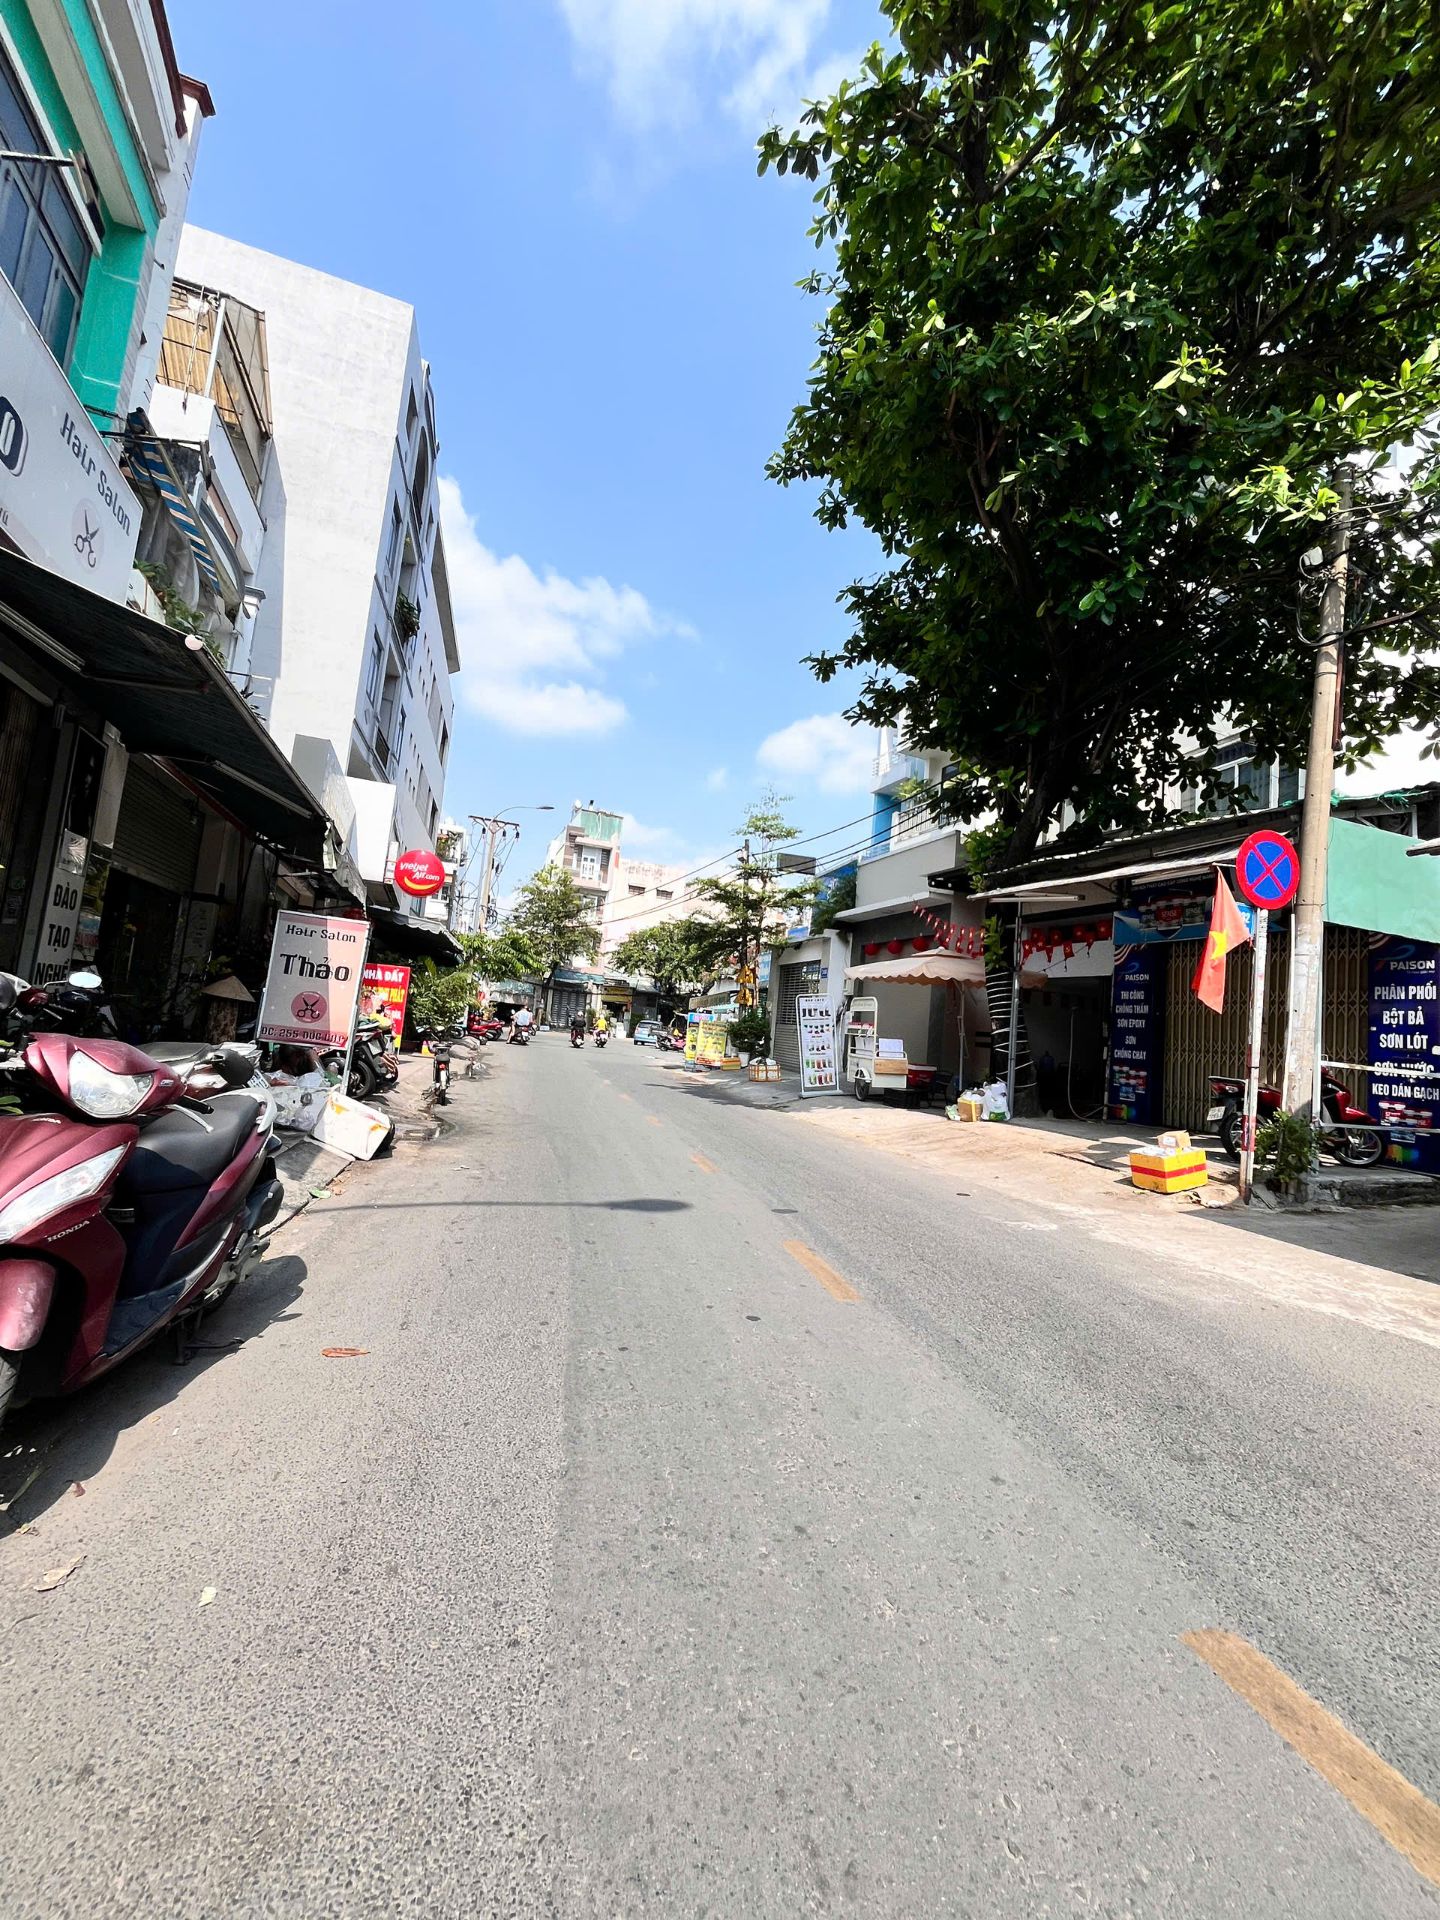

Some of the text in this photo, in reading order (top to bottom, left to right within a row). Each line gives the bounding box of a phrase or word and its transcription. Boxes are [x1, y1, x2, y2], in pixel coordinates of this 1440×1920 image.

[60, 412, 131, 537] Hair Salon
[53, 882, 78, 911] ĐÀO
[48, 924, 70, 952] TẠO
[286, 924, 356, 943] Hair Salon
[280, 953, 352, 982] Thảo
[1390, 960, 1436, 970] PAISON
[1374, 981, 1437, 1000] PHÂN PHỐI
[1129, 1019, 1146, 1028] EPOXY
[1383, 1006, 1425, 1028] BỘT BẢ
[280, 1028, 298, 1039] 255
[1379, 1032, 1429, 1050] SƠN LÓT
[1372, 1083, 1440, 1101] KEO DÁN GẠCH
[48, 1220, 90, 1242] HONDA
